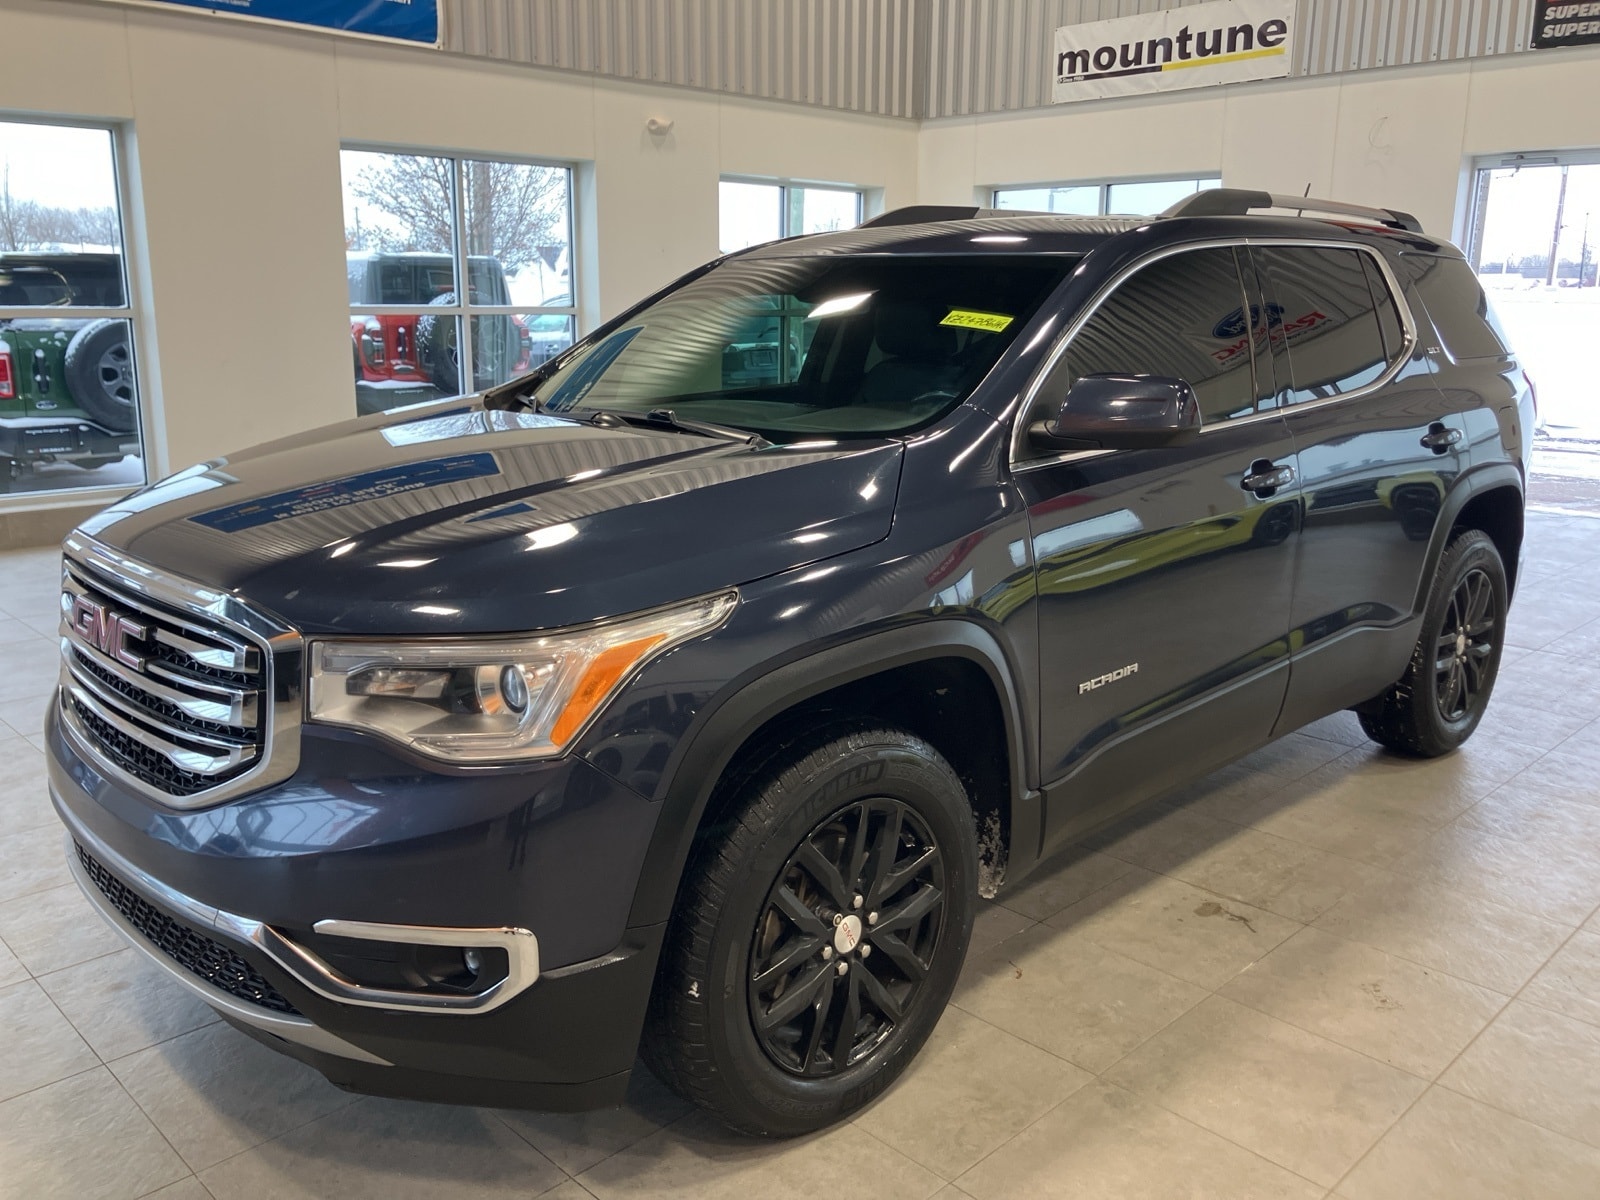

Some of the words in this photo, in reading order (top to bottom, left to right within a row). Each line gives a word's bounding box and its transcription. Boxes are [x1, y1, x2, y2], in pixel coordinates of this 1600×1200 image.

[1542, 21, 1600, 38] SUPER
[1057, 18, 1287, 76] mountune
[73, 594, 147, 673] GMC
[1079, 662, 1138, 695] ACADIA
[842, 922, 855, 947] GMC
